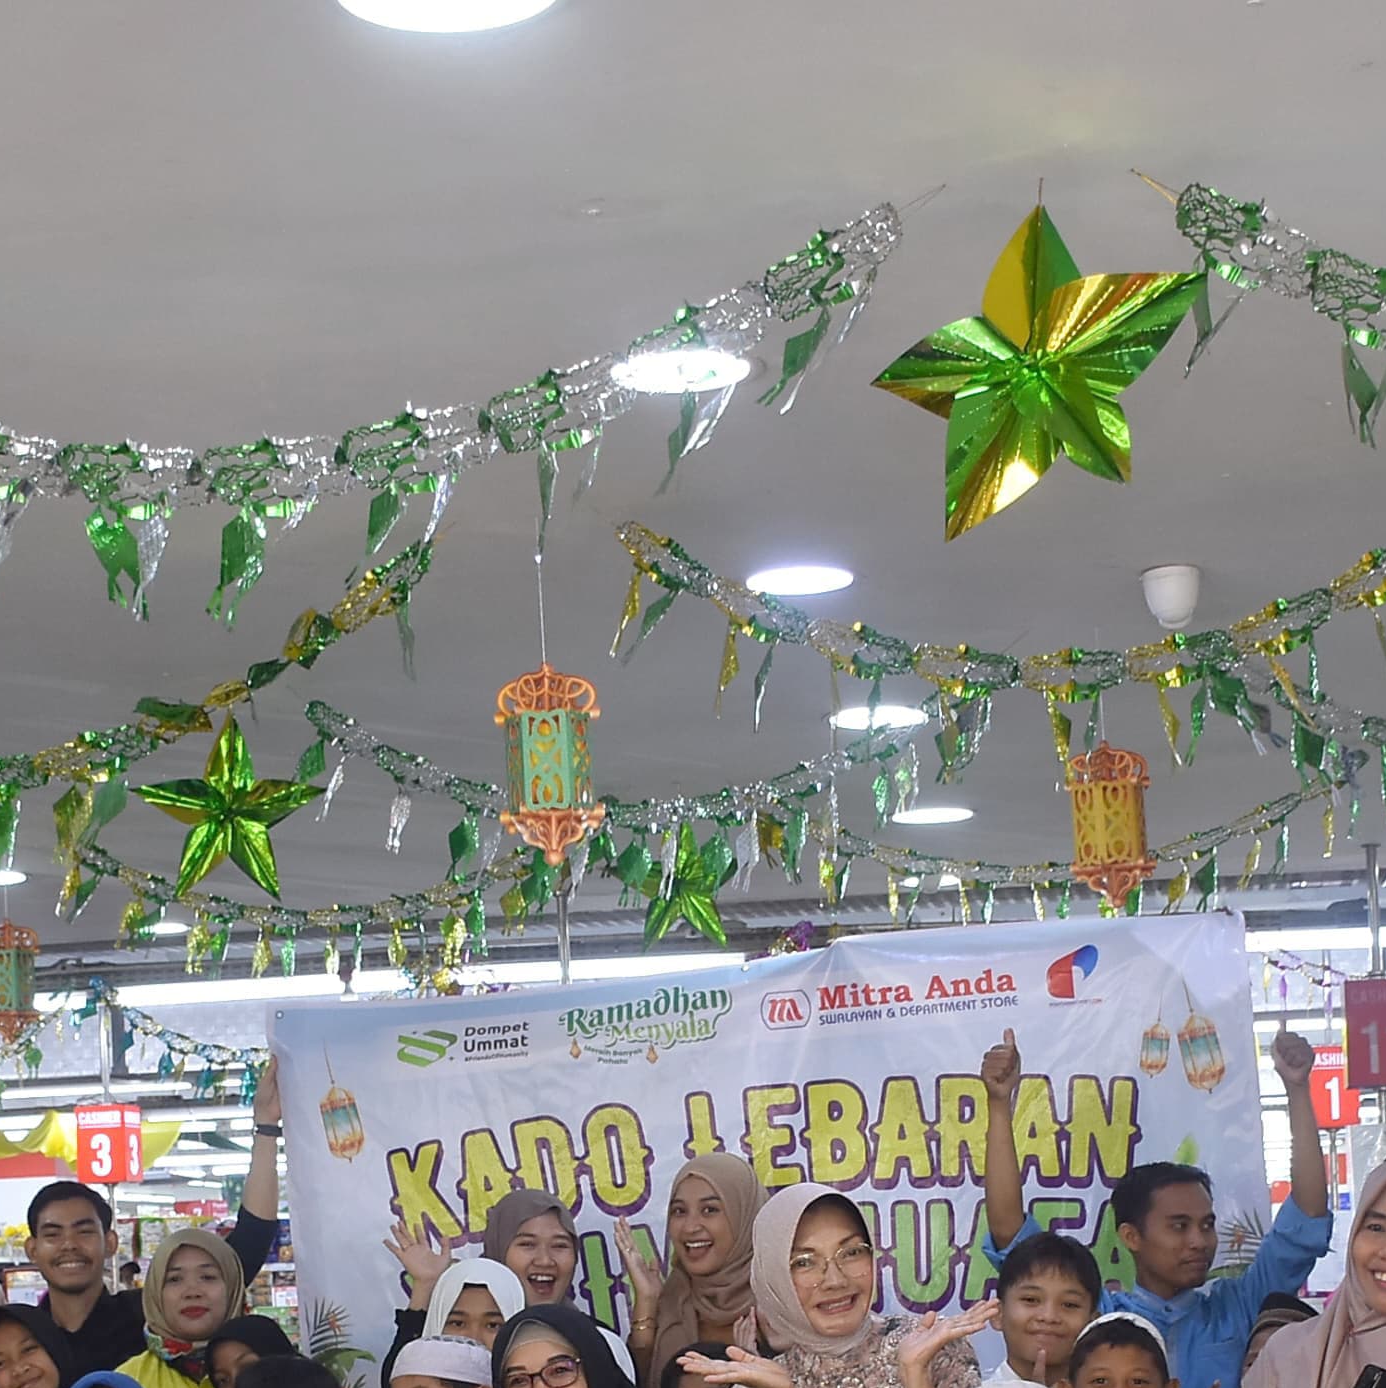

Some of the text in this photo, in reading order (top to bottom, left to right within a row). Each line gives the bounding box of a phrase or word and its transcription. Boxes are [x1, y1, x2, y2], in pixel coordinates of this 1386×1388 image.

[816, 969, 1017, 1011] Mitra Anda
[818, 995, 1019, 1026] SWALAYAN & DEPARTMENT STORE
[464, 1021, 530, 1039] Dompet
[559, 985, 733, 1039] Ramadhan
[605, 1010, 717, 1049] Menyala
[463, 1033, 529, 1053] Ummat
[1324, 1075, 1341, 1121] 1
[89, 1133, 113, 1177] 3
[128, 1133, 140, 1176] 3
[386, 1102, 652, 1248] KADO
